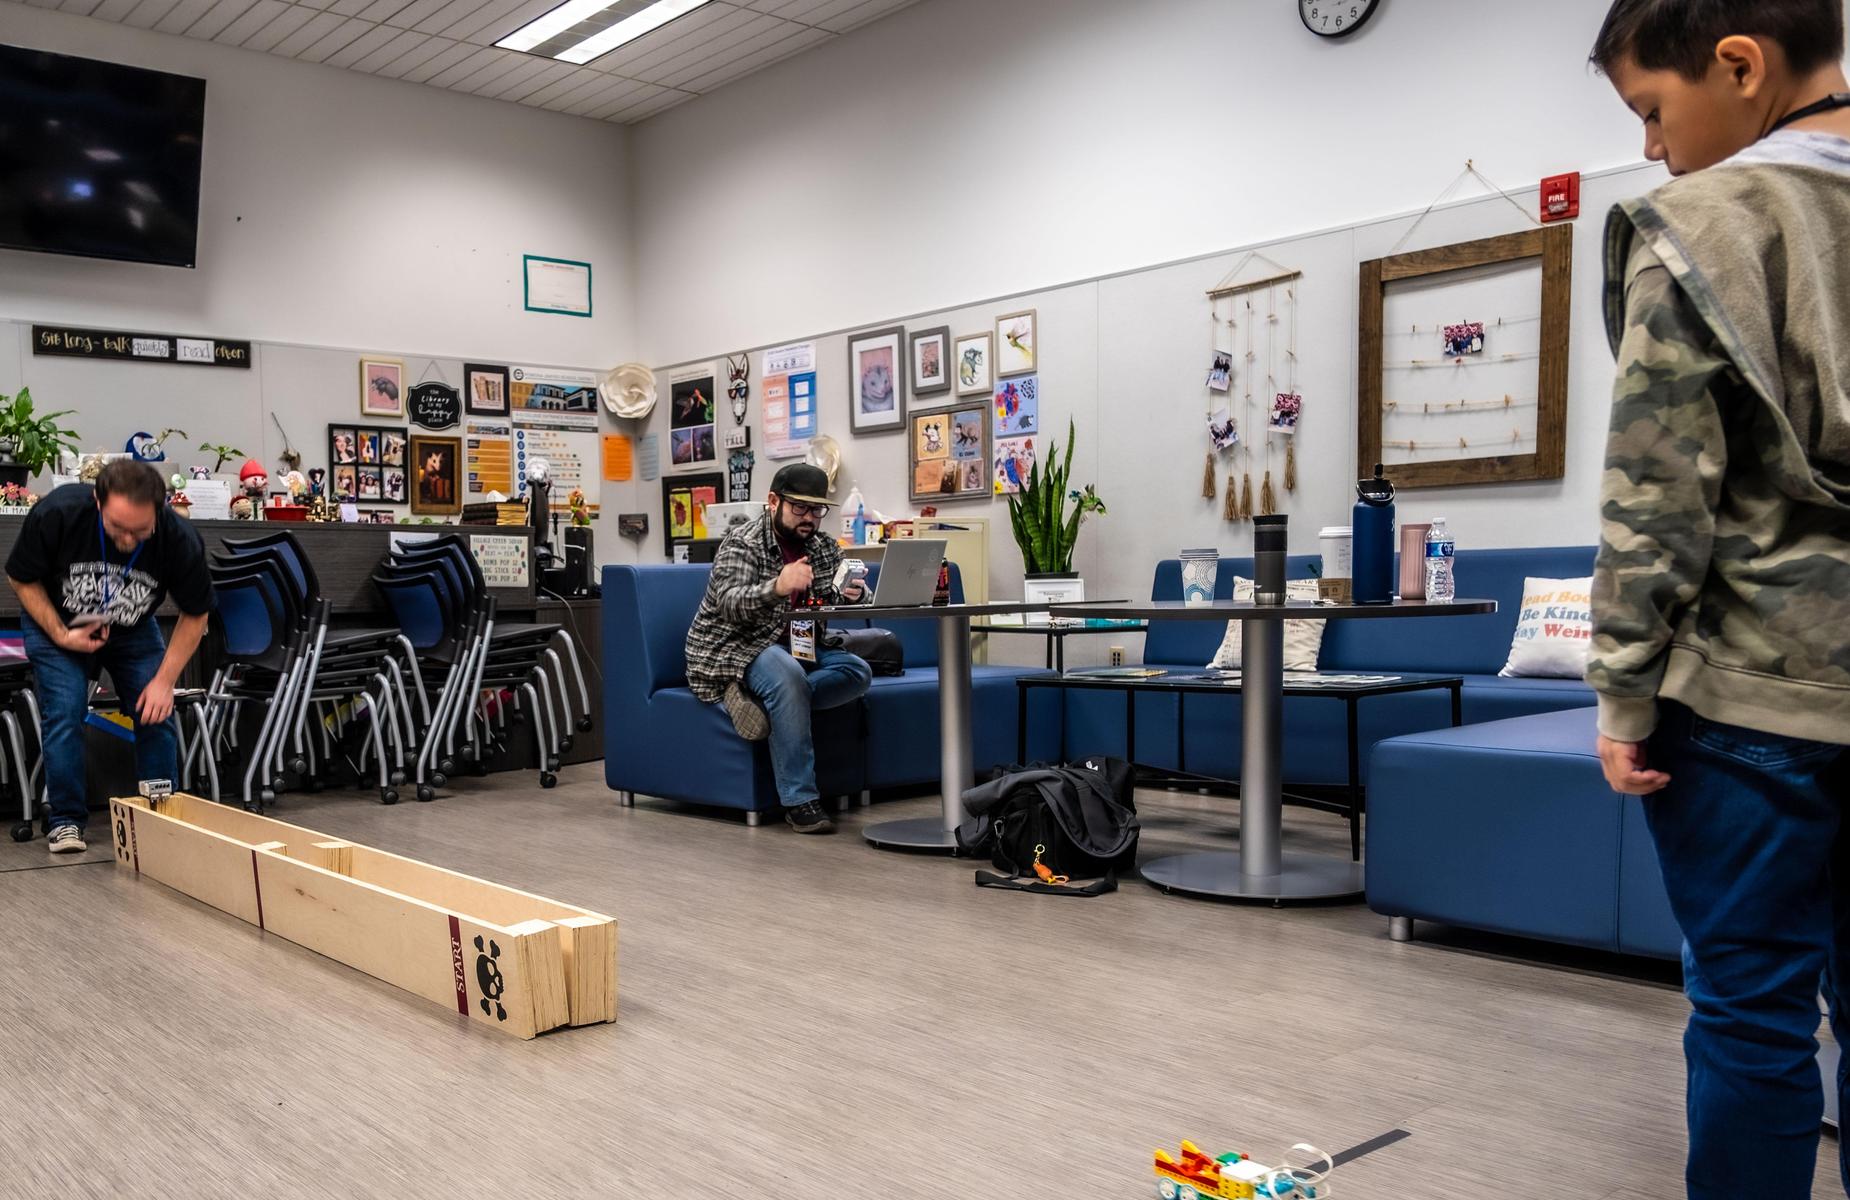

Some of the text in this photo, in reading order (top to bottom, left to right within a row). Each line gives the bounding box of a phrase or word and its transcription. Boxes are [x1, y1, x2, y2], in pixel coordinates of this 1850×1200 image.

[1311, 8, 1319, 19] 8
[1350, 6, 1358, 18] 5
[1322, 15, 1329, 27] 7
[1335, 15, 1343, 27] 6
[1548, 193, 1565, 203] FIRE
[41, 331, 61, 346] Sit
[103, 336, 132, 353] talk
[183, 343, 210, 359] read
[1522, 608, 1540, 621] Be
[1544, 623, 1592, 640] Weir
[451, 937, 465, 993] START
